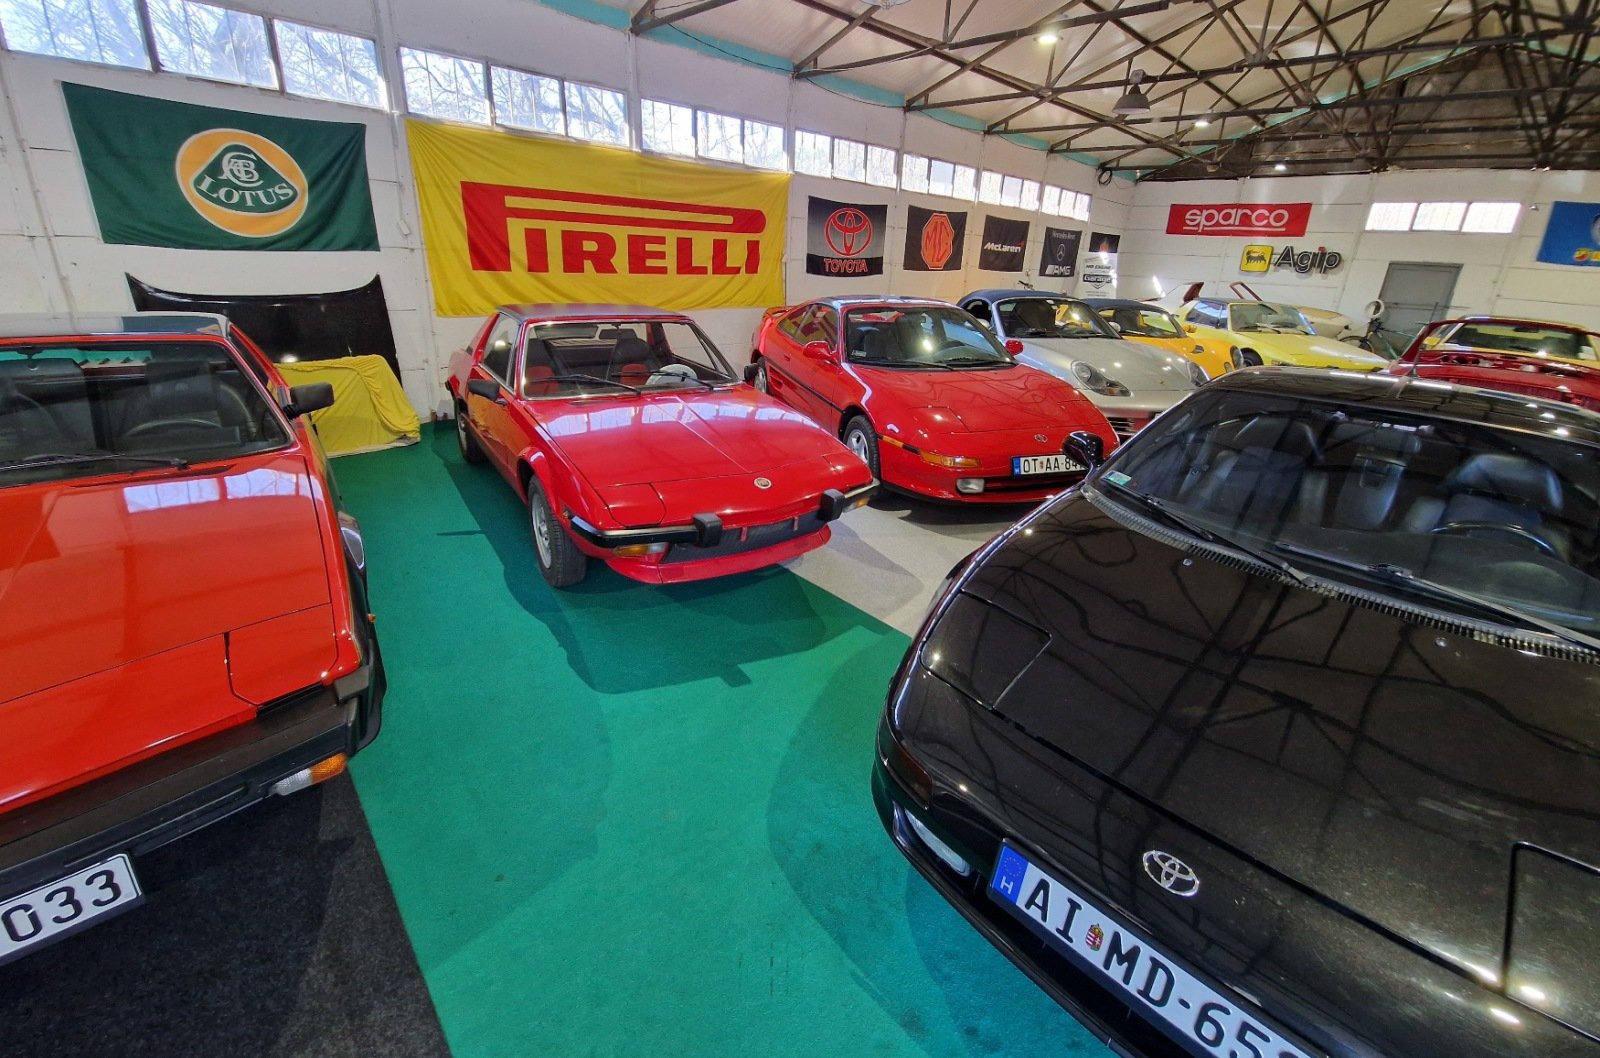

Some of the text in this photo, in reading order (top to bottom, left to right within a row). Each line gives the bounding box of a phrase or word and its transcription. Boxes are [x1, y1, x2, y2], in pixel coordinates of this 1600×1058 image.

[197, 174, 294, 207] LOTUS
[460, 181, 766, 275] PIRELLI
[1185, 208, 1289, 232] sparco
[925, 221, 950, 263] MG
[984, 242, 1022, 253] McLaren
[823, 258, 869, 273] TOYOTA
[1274, 245, 1342, 274] Agip
[1023, 458, 1039, 473] OT
[1000, 874, 1014, 894] H
[1024, 878, 1302, 1058] AI MD-65
